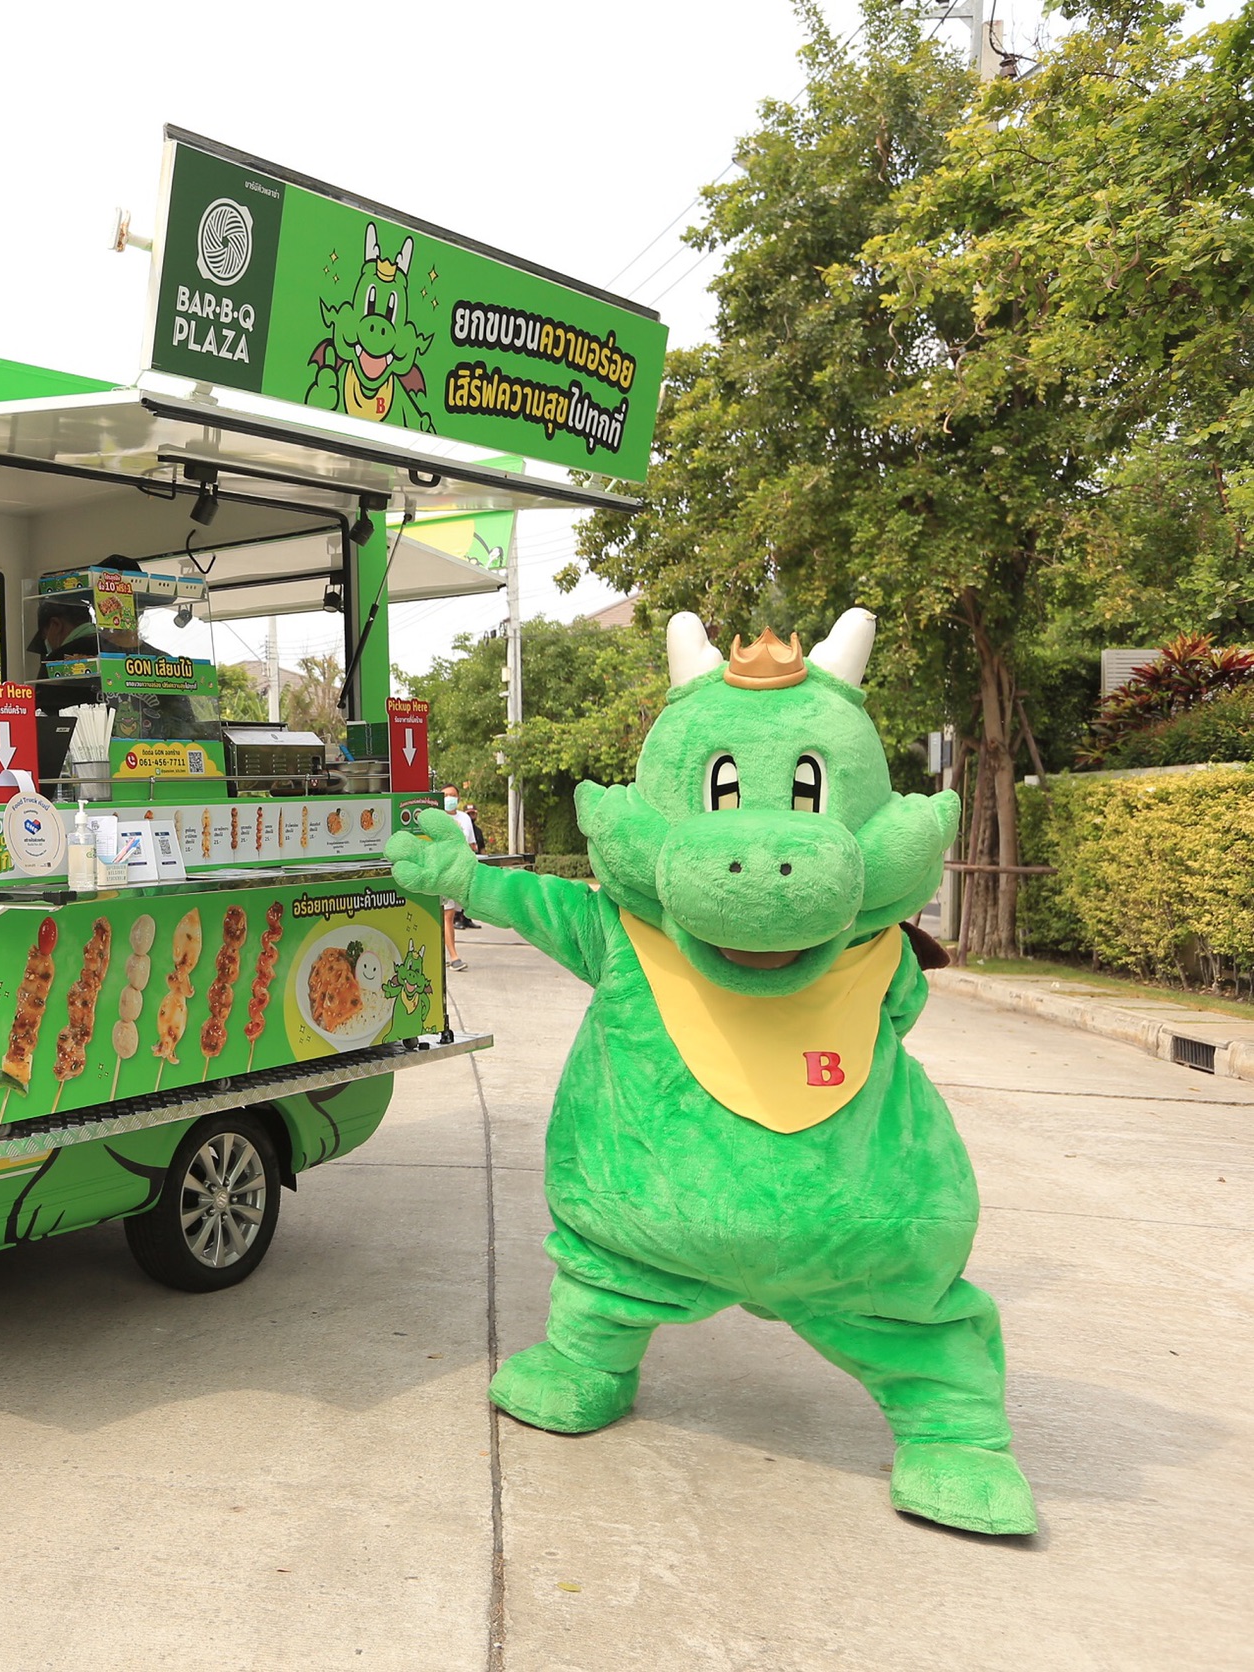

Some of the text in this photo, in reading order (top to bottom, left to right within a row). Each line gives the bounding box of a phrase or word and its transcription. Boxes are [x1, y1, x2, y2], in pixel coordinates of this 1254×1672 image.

[172, 316, 250, 364] PLAZA
[454, 307, 634, 389] ยกขบวนความอร่อย
[376, 397, 386, 414] B
[448, 368, 626, 449] เสิร์ฟความสุขไปทุกที่
[106, 582, 116, 591] 10
[126, 658, 193, 678] GON เสียบไม้
[7, 685, 33, 699] Here
[388, 700, 428, 714] Pickup Here
[139, 758, 186, 767] 061-456-7711
[11, 798, 24, 811] Food
[802, 1051, 845, 1087] B
